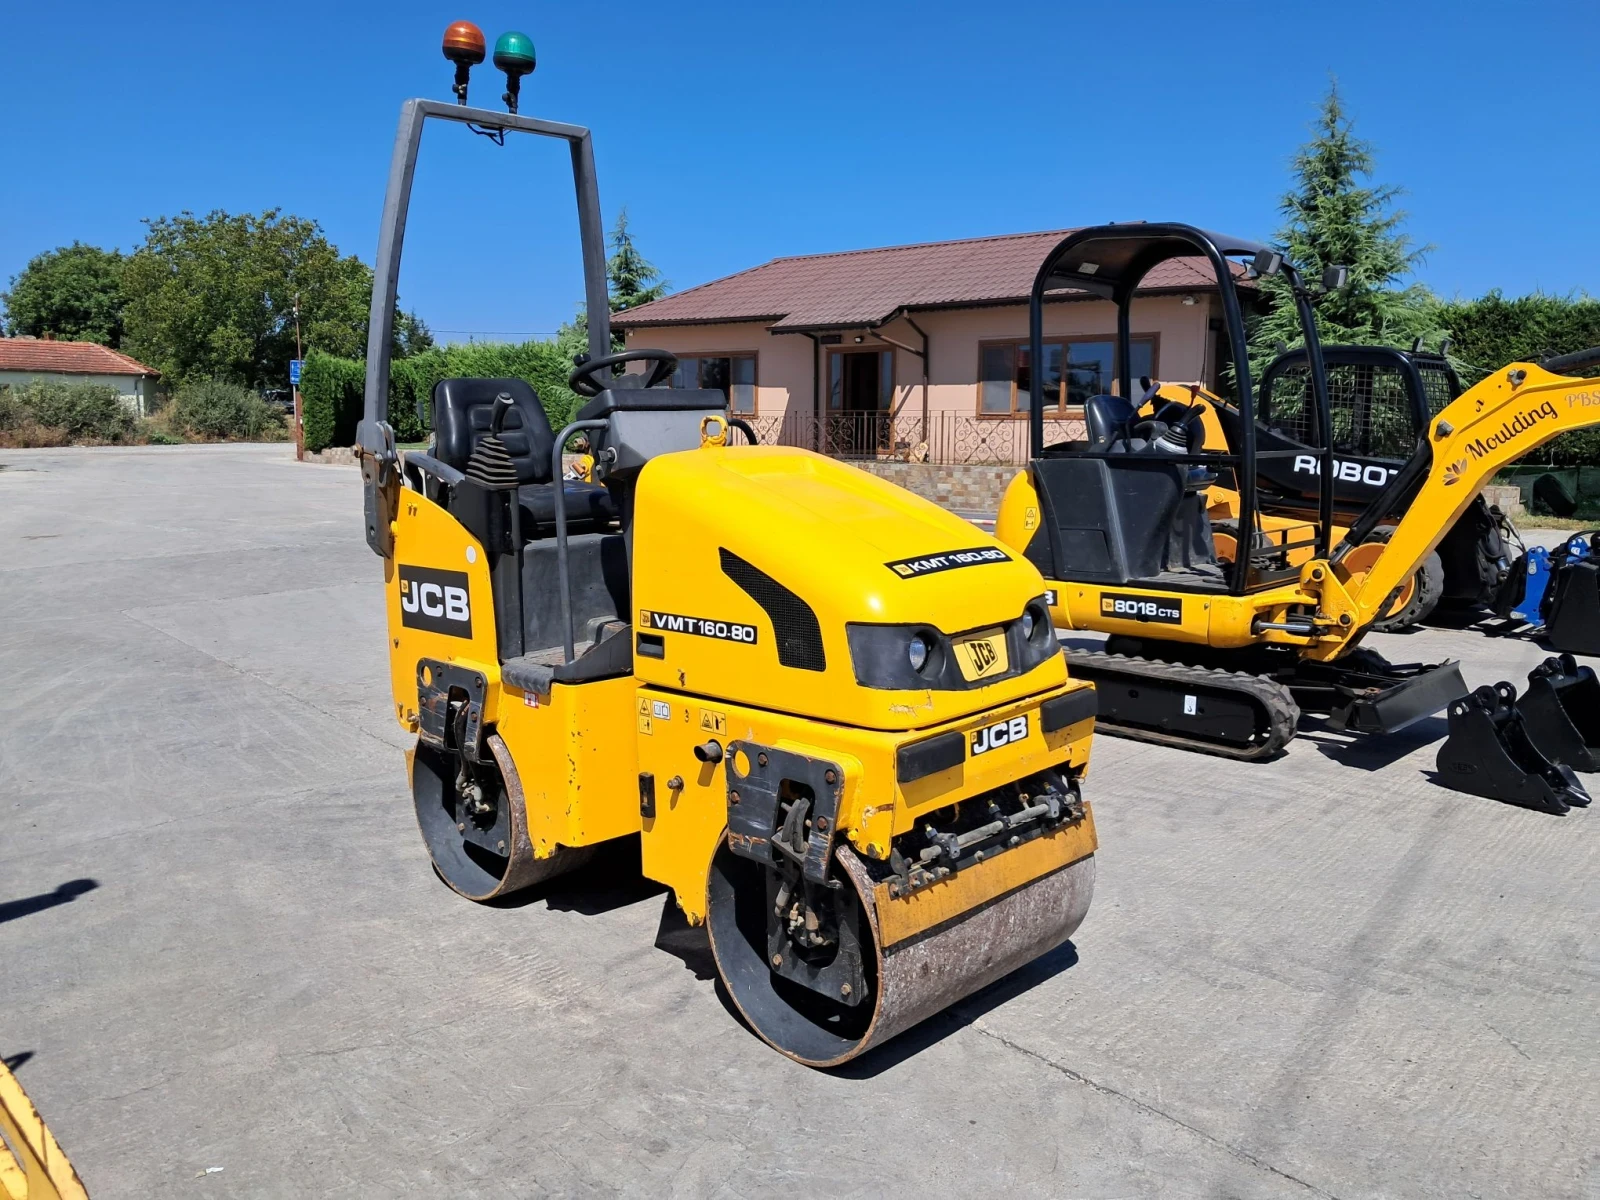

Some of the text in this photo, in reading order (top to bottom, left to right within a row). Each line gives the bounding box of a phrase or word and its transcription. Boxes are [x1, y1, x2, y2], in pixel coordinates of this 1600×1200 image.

[1465, 401, 1558, 461] Moulding
[1293, 455, 1399, 486] ROBO
[908, 556, 950, 572] KMT
[402, 581, 470, 622] JCB
[1114, 600, 1157, 616] 8018
[969, 642, 996, 672] JCB
[973, 716, 1028, 754] JCB
